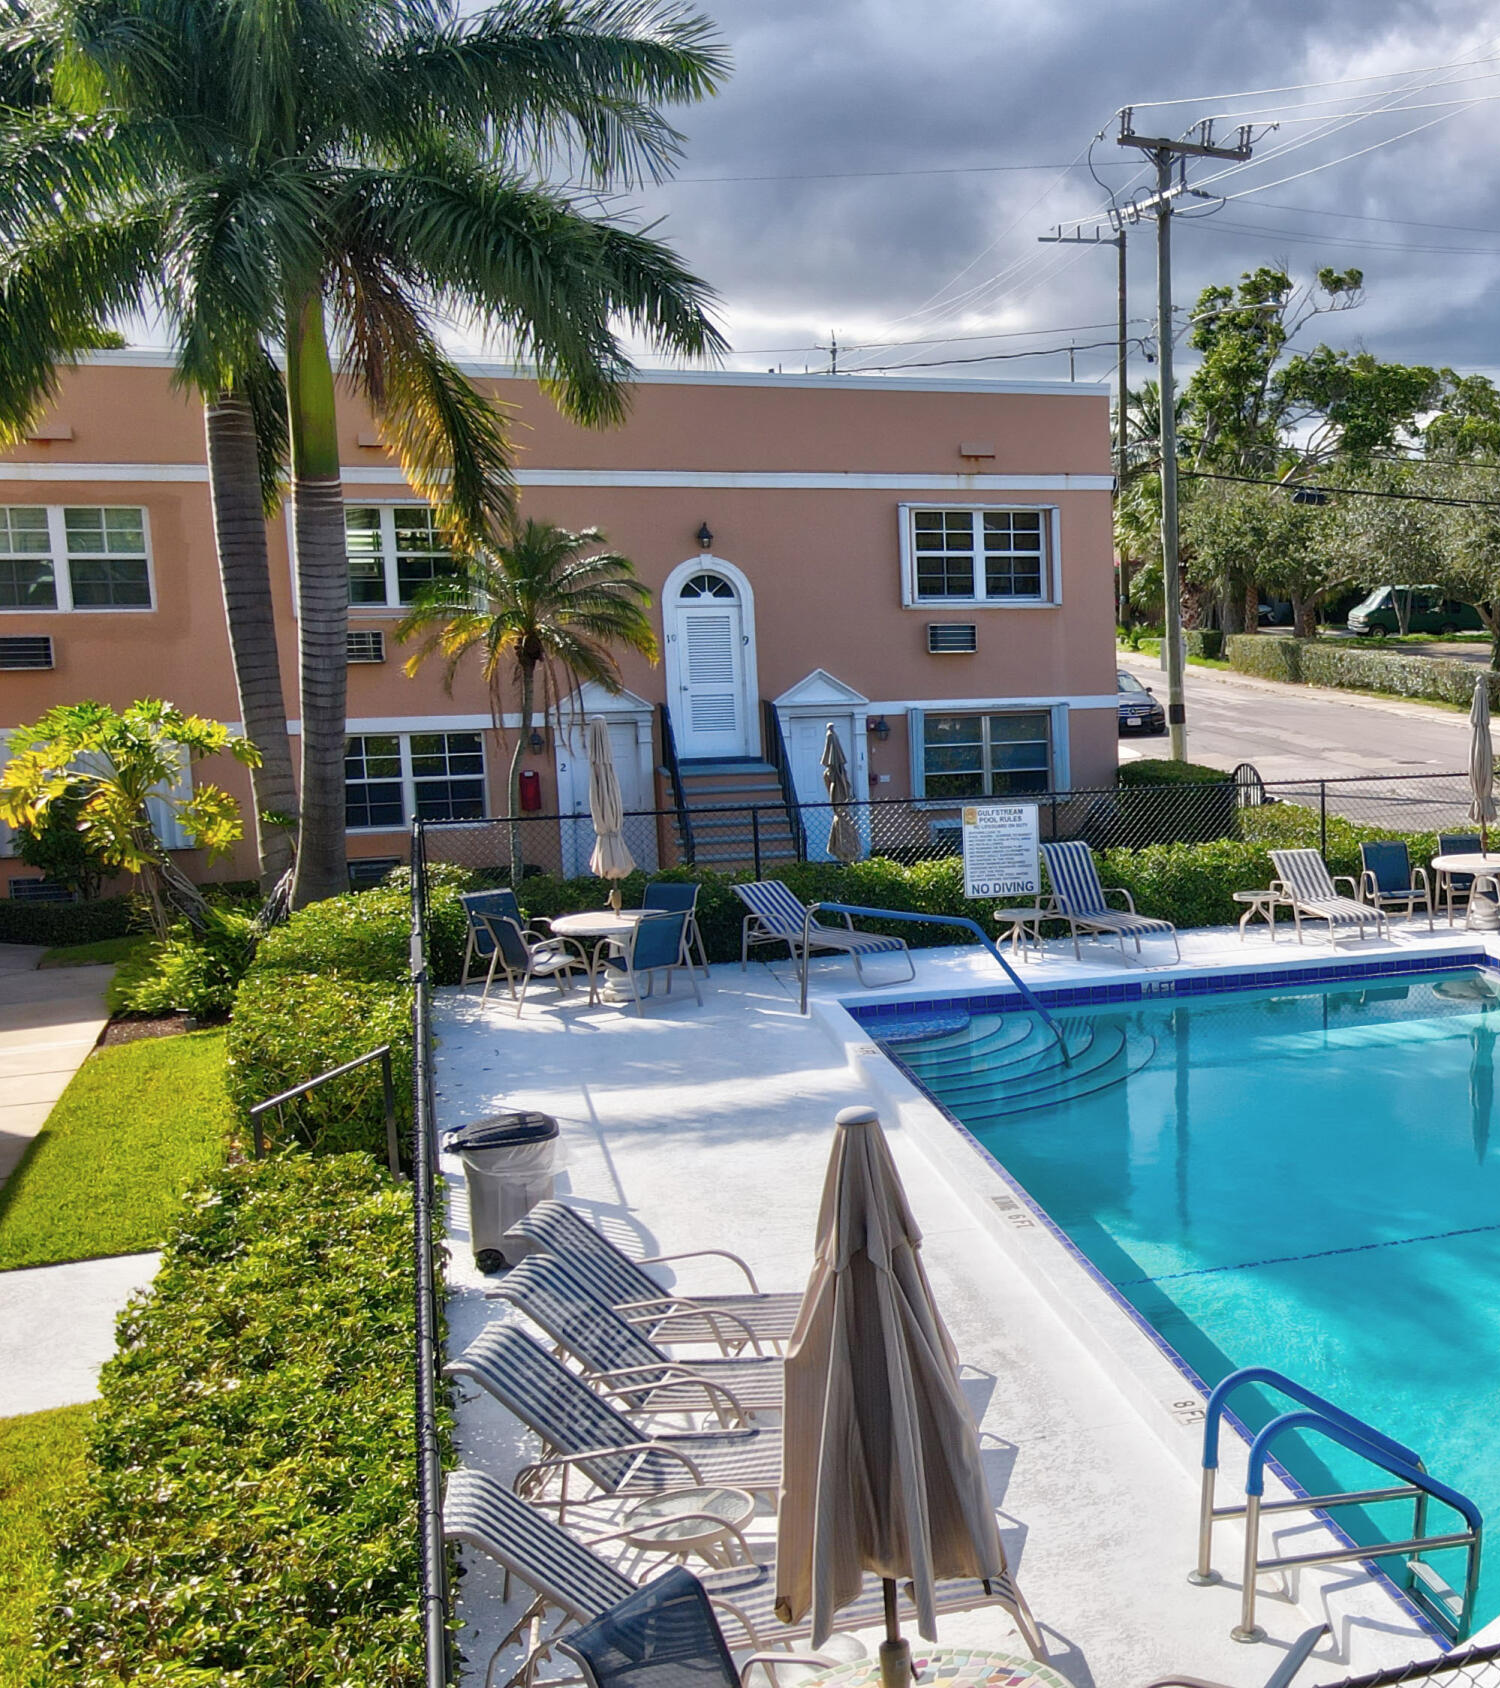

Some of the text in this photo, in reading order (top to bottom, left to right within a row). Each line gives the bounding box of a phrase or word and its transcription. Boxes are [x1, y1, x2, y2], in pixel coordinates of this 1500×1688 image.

[667, 634, 677, 644] 10
[742, 635, 750, 646] 9
[560, 763, 567, 772] 2
[978, 808, 1024, 816] GULFSTREAM
[972, 881, 1034, 894] NO DIVING
[1180, 1410, 1205, 1421] FT
